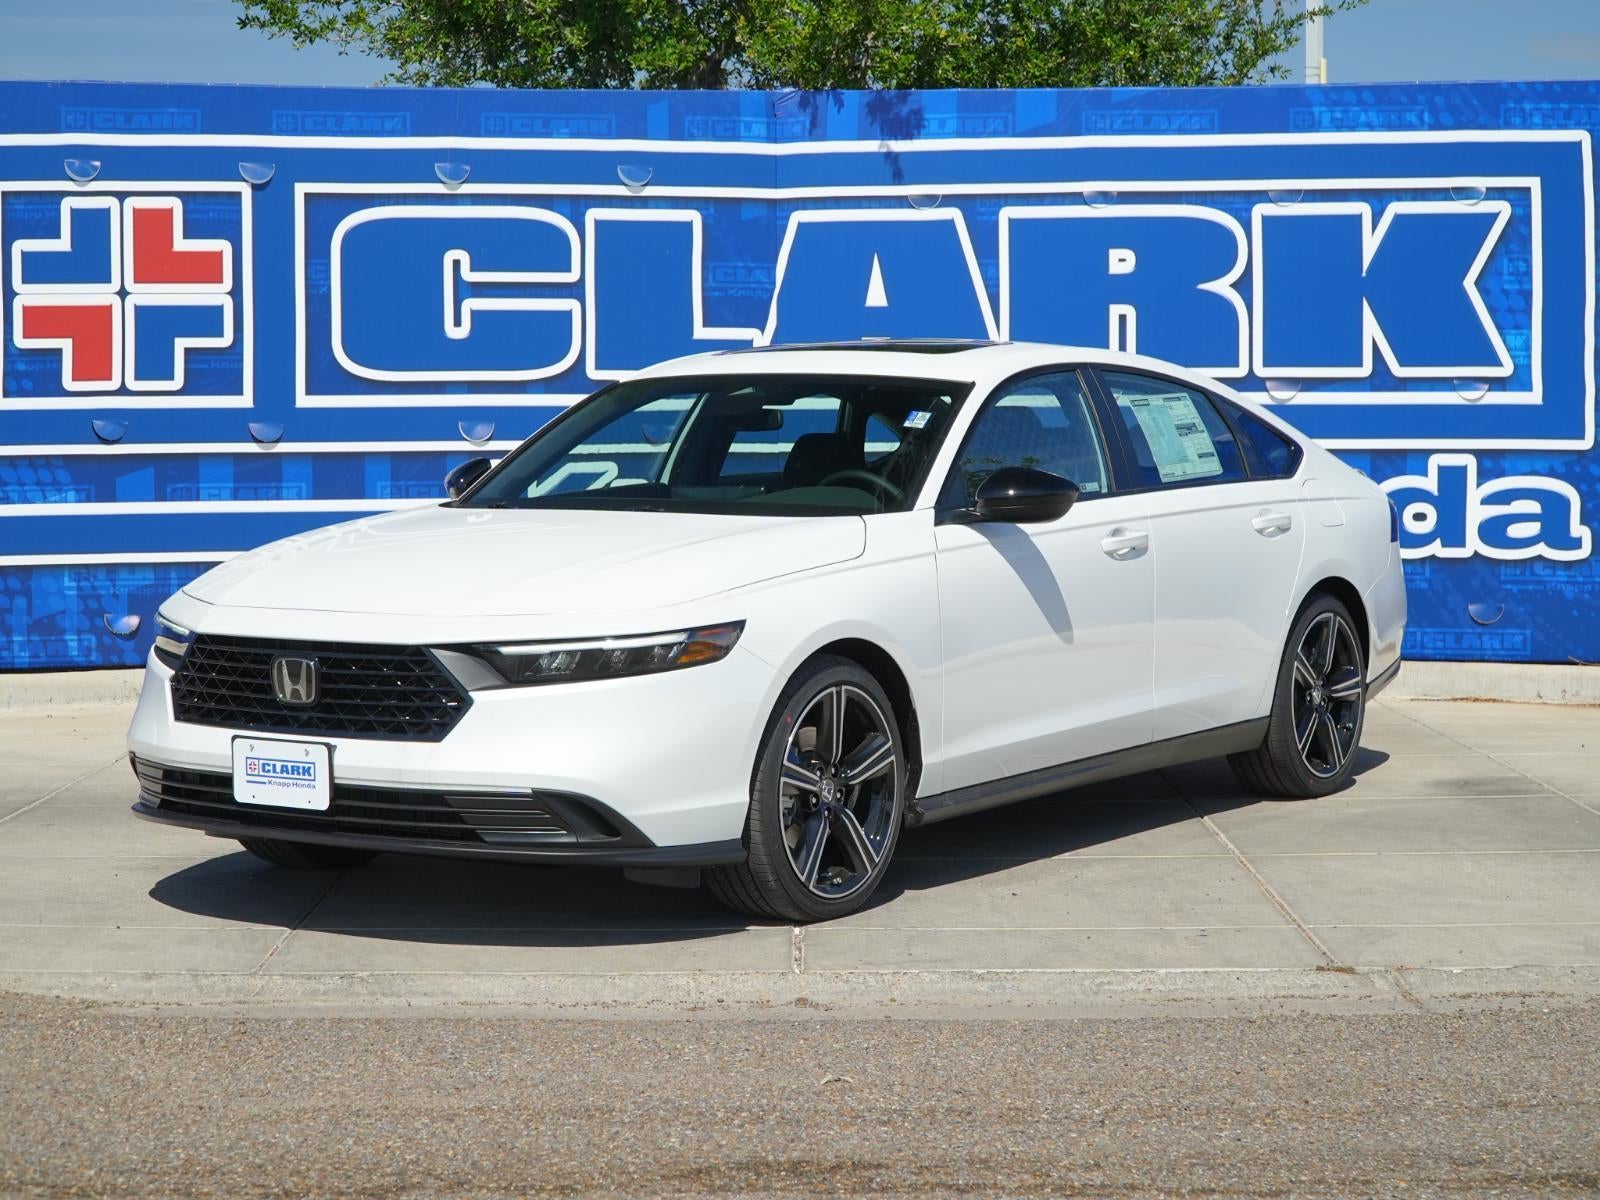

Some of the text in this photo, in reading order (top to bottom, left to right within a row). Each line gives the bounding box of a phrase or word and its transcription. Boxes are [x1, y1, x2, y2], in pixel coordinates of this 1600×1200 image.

[94, 112, 195, 129] CLARK
[304, 115, 405, 132] CLARK
[511, 118, 609, 134] CLARK
[1113, 113, 1213, 130] CLARK
[330, 201, 1514, 382] CLARK
[1378, 453, 1592, 561] da
[1423, 633, 1526, 649] CLARK
[261, 762, 313, 777] CLARK
[267, 779, 316, 789] Knapp Honda
